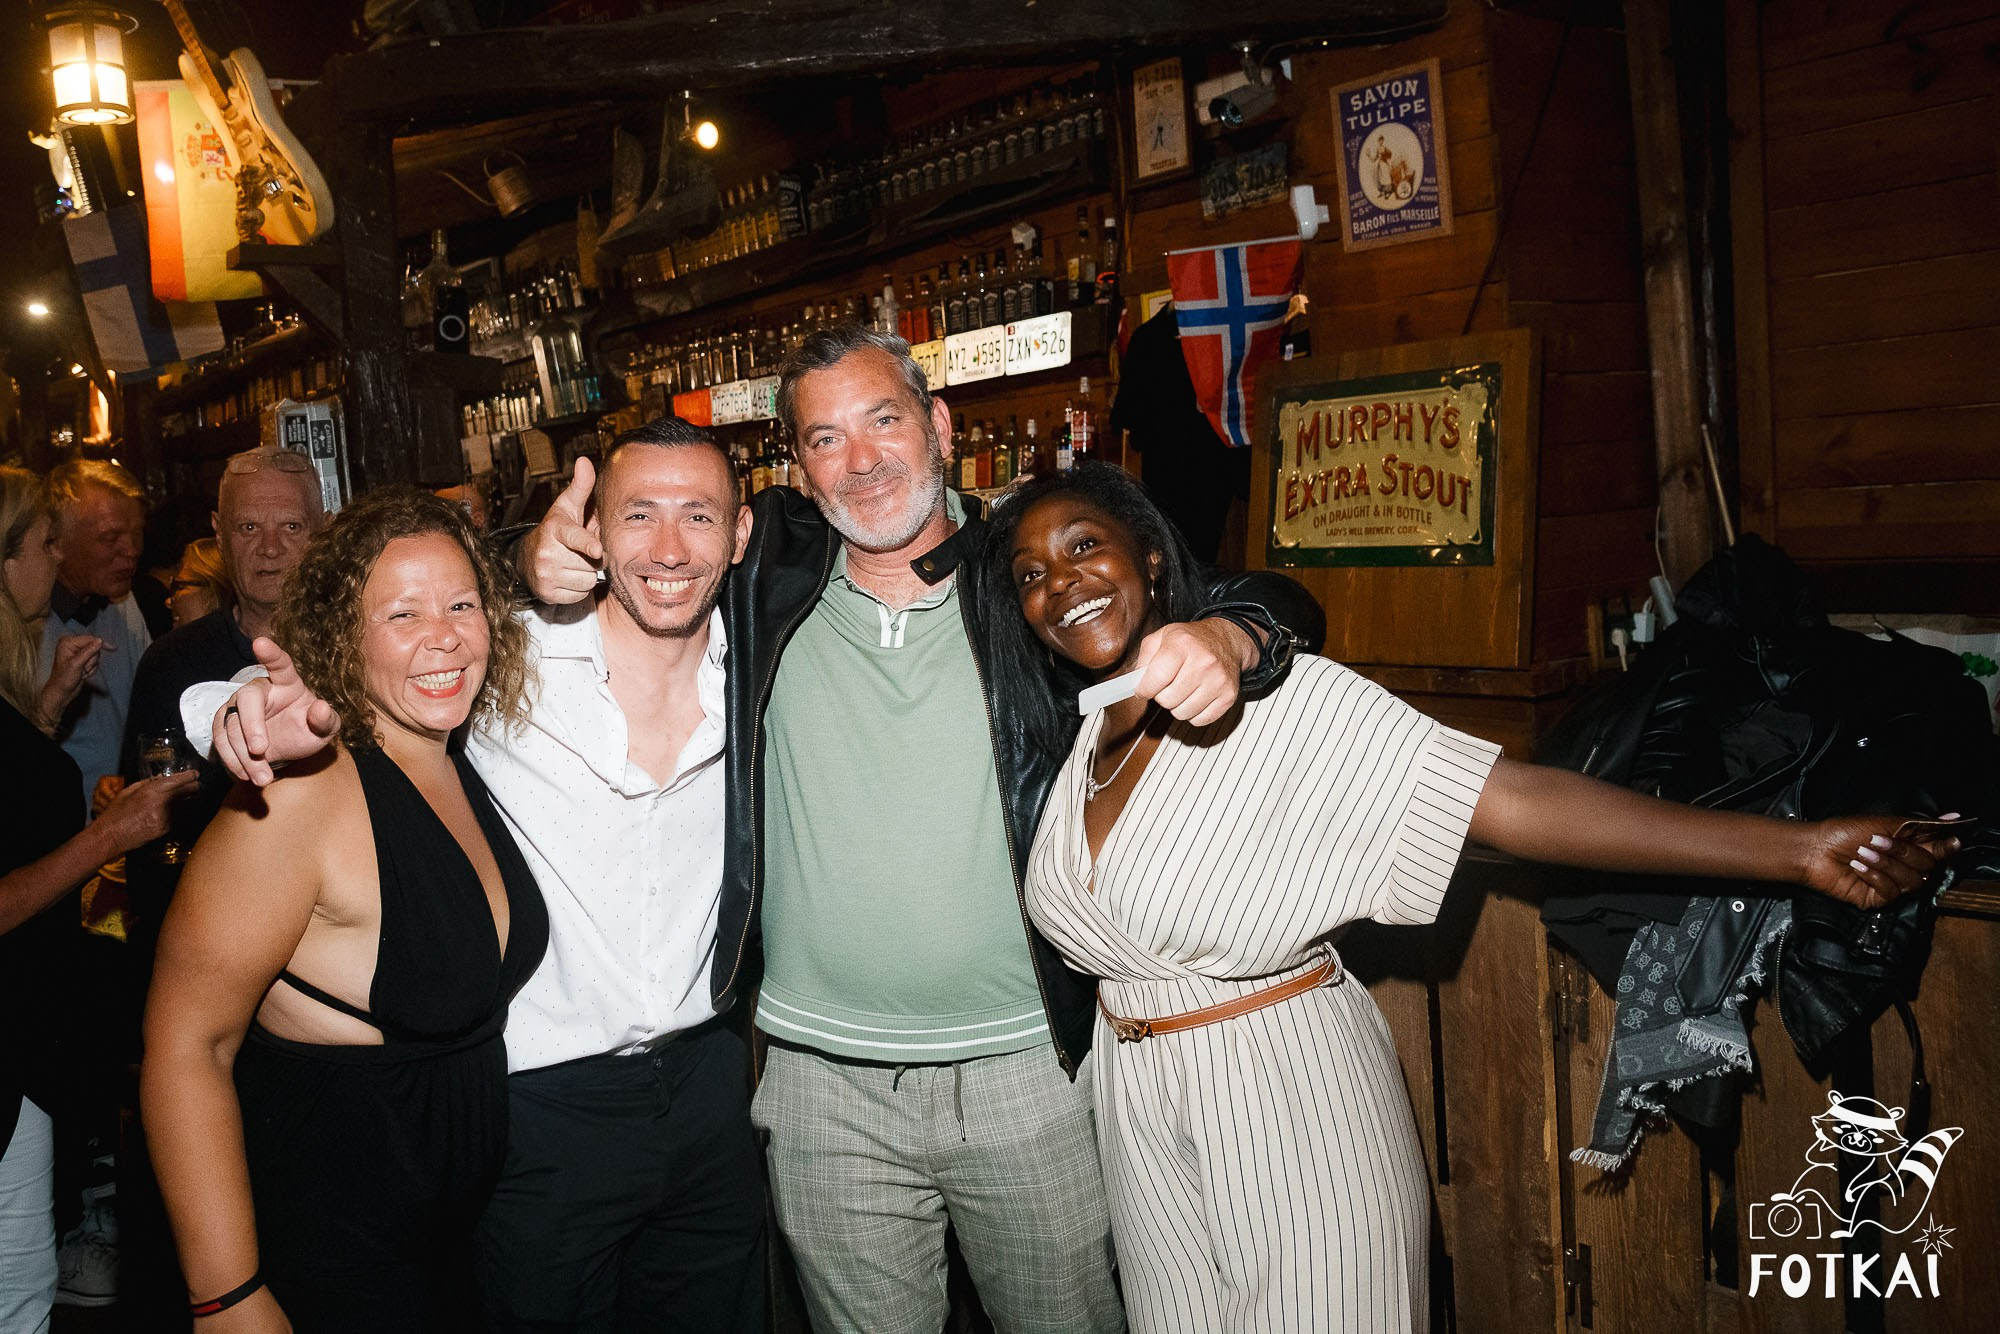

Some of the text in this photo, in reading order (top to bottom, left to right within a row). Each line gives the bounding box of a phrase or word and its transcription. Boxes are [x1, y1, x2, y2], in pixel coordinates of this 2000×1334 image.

[1350, 80, 1418, 112] SAVON
[1346, 98, 1426, 130] TULIPE
[1352, 214, 1386, 234] BARON
[1400, 206, 1440, 222] MARSEILLE
[948, 346, 967, 371] AYZ
[1008, 329, 1067, 362] ZXN 526
[1296, 399, 1460, 468] MURPHY'S
[1284, 453, 1472, 521] EXTRA STOUT
[1313, 504, 1433, 529] ON DRAUGHT & IN BOTTLE
